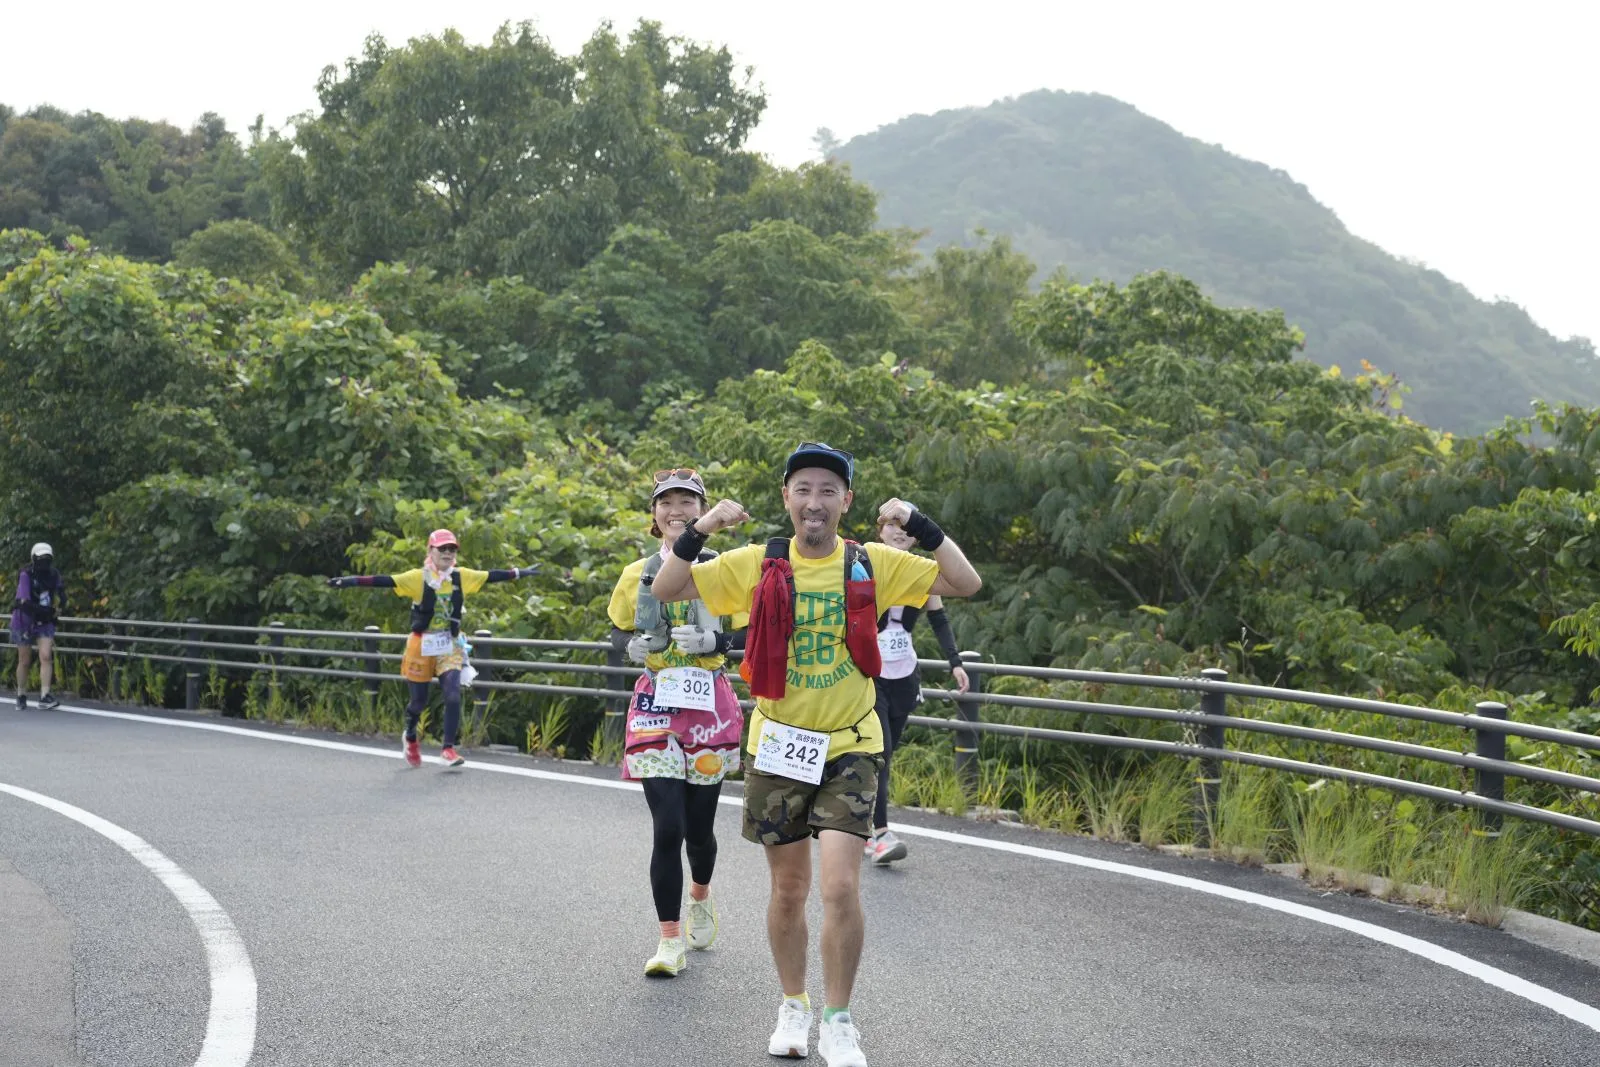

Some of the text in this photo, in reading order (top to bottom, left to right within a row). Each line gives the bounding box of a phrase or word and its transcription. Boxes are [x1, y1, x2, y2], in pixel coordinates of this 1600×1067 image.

[796, 631, 835, 665] 26
[683, 679, 710, 696] 302
[786, 668, 803, 688] ON
[784, 742, 819, 765] 242
